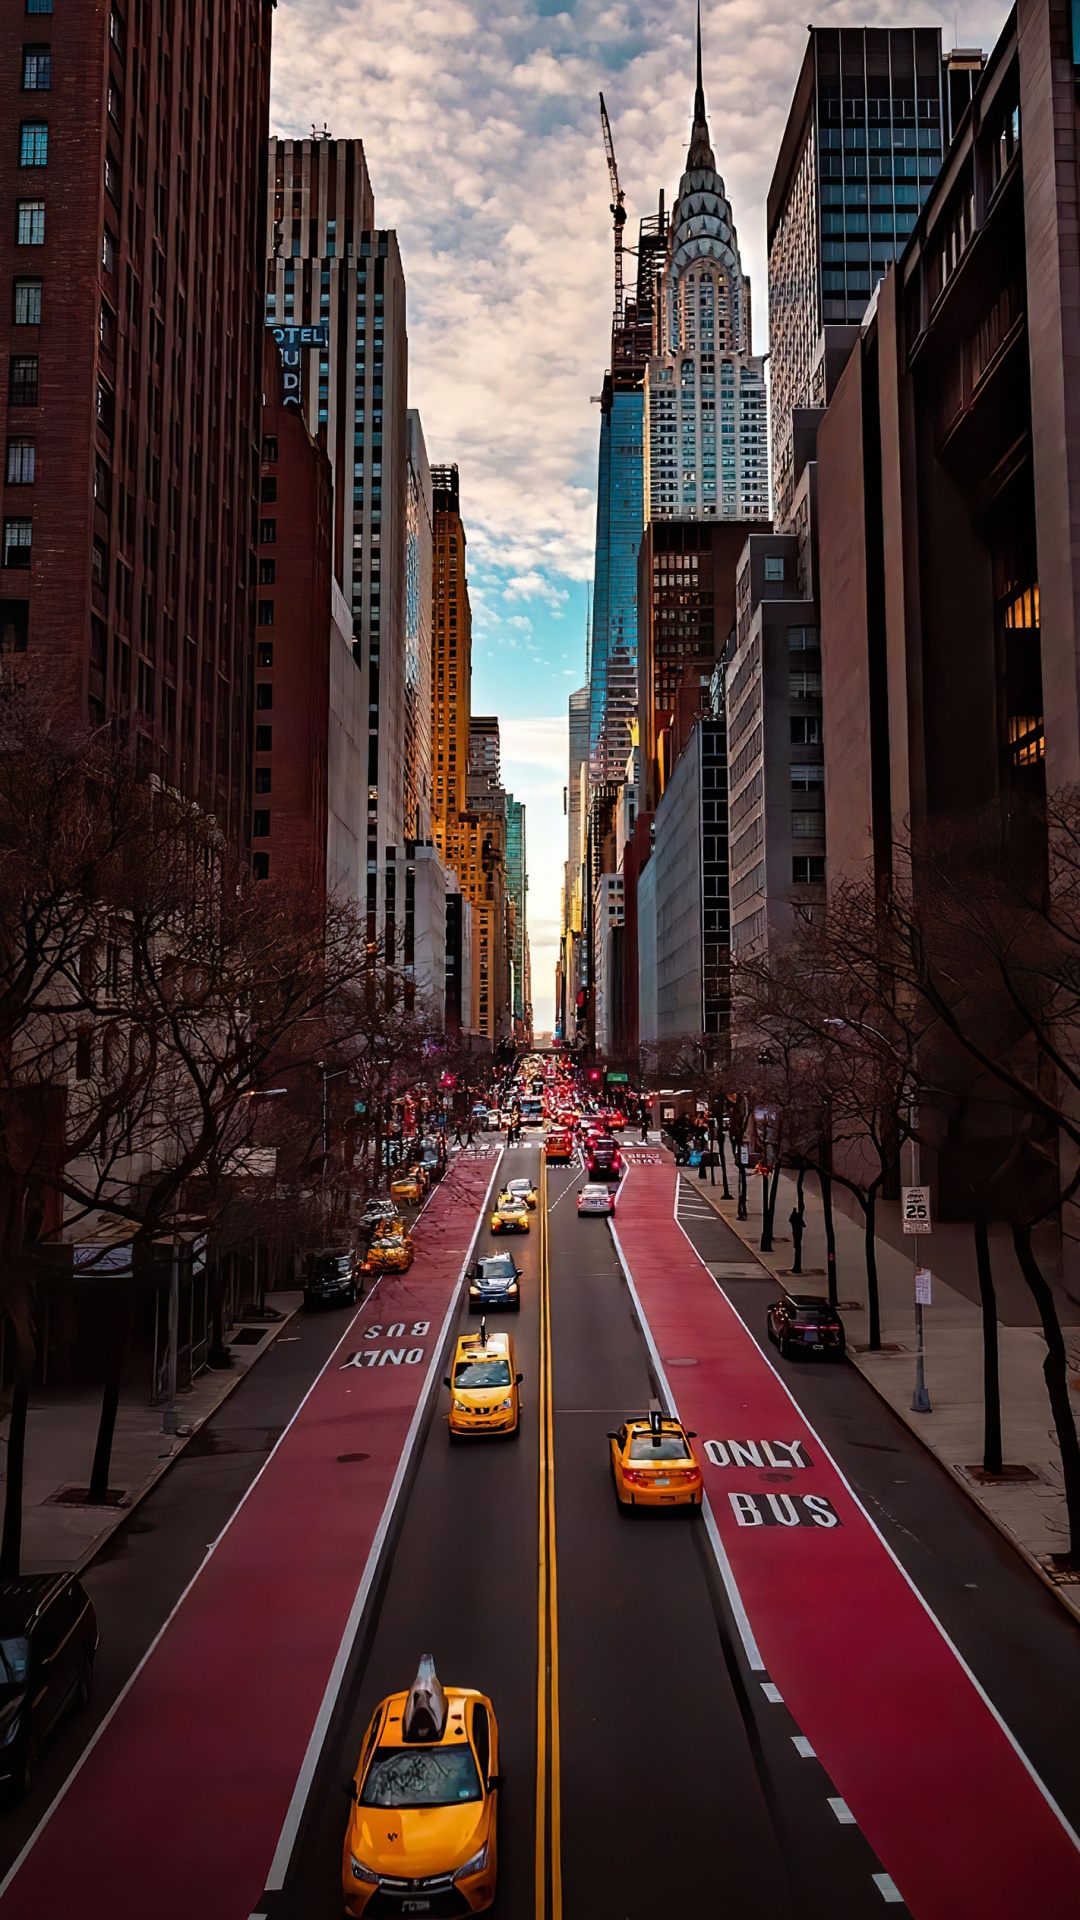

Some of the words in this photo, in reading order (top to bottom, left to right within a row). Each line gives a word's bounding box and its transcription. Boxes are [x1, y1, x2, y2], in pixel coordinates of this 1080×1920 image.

[272, 327, 324, 343] OTEL
[906, 1204, 927, 1218] 25
[364, 1321, 431, 1339] BUS
[339, 1348, 424, 1370] ONLY
[703, 1439, 806, 1468] ONLY
[727, 1492, 838, 1528] BUS
